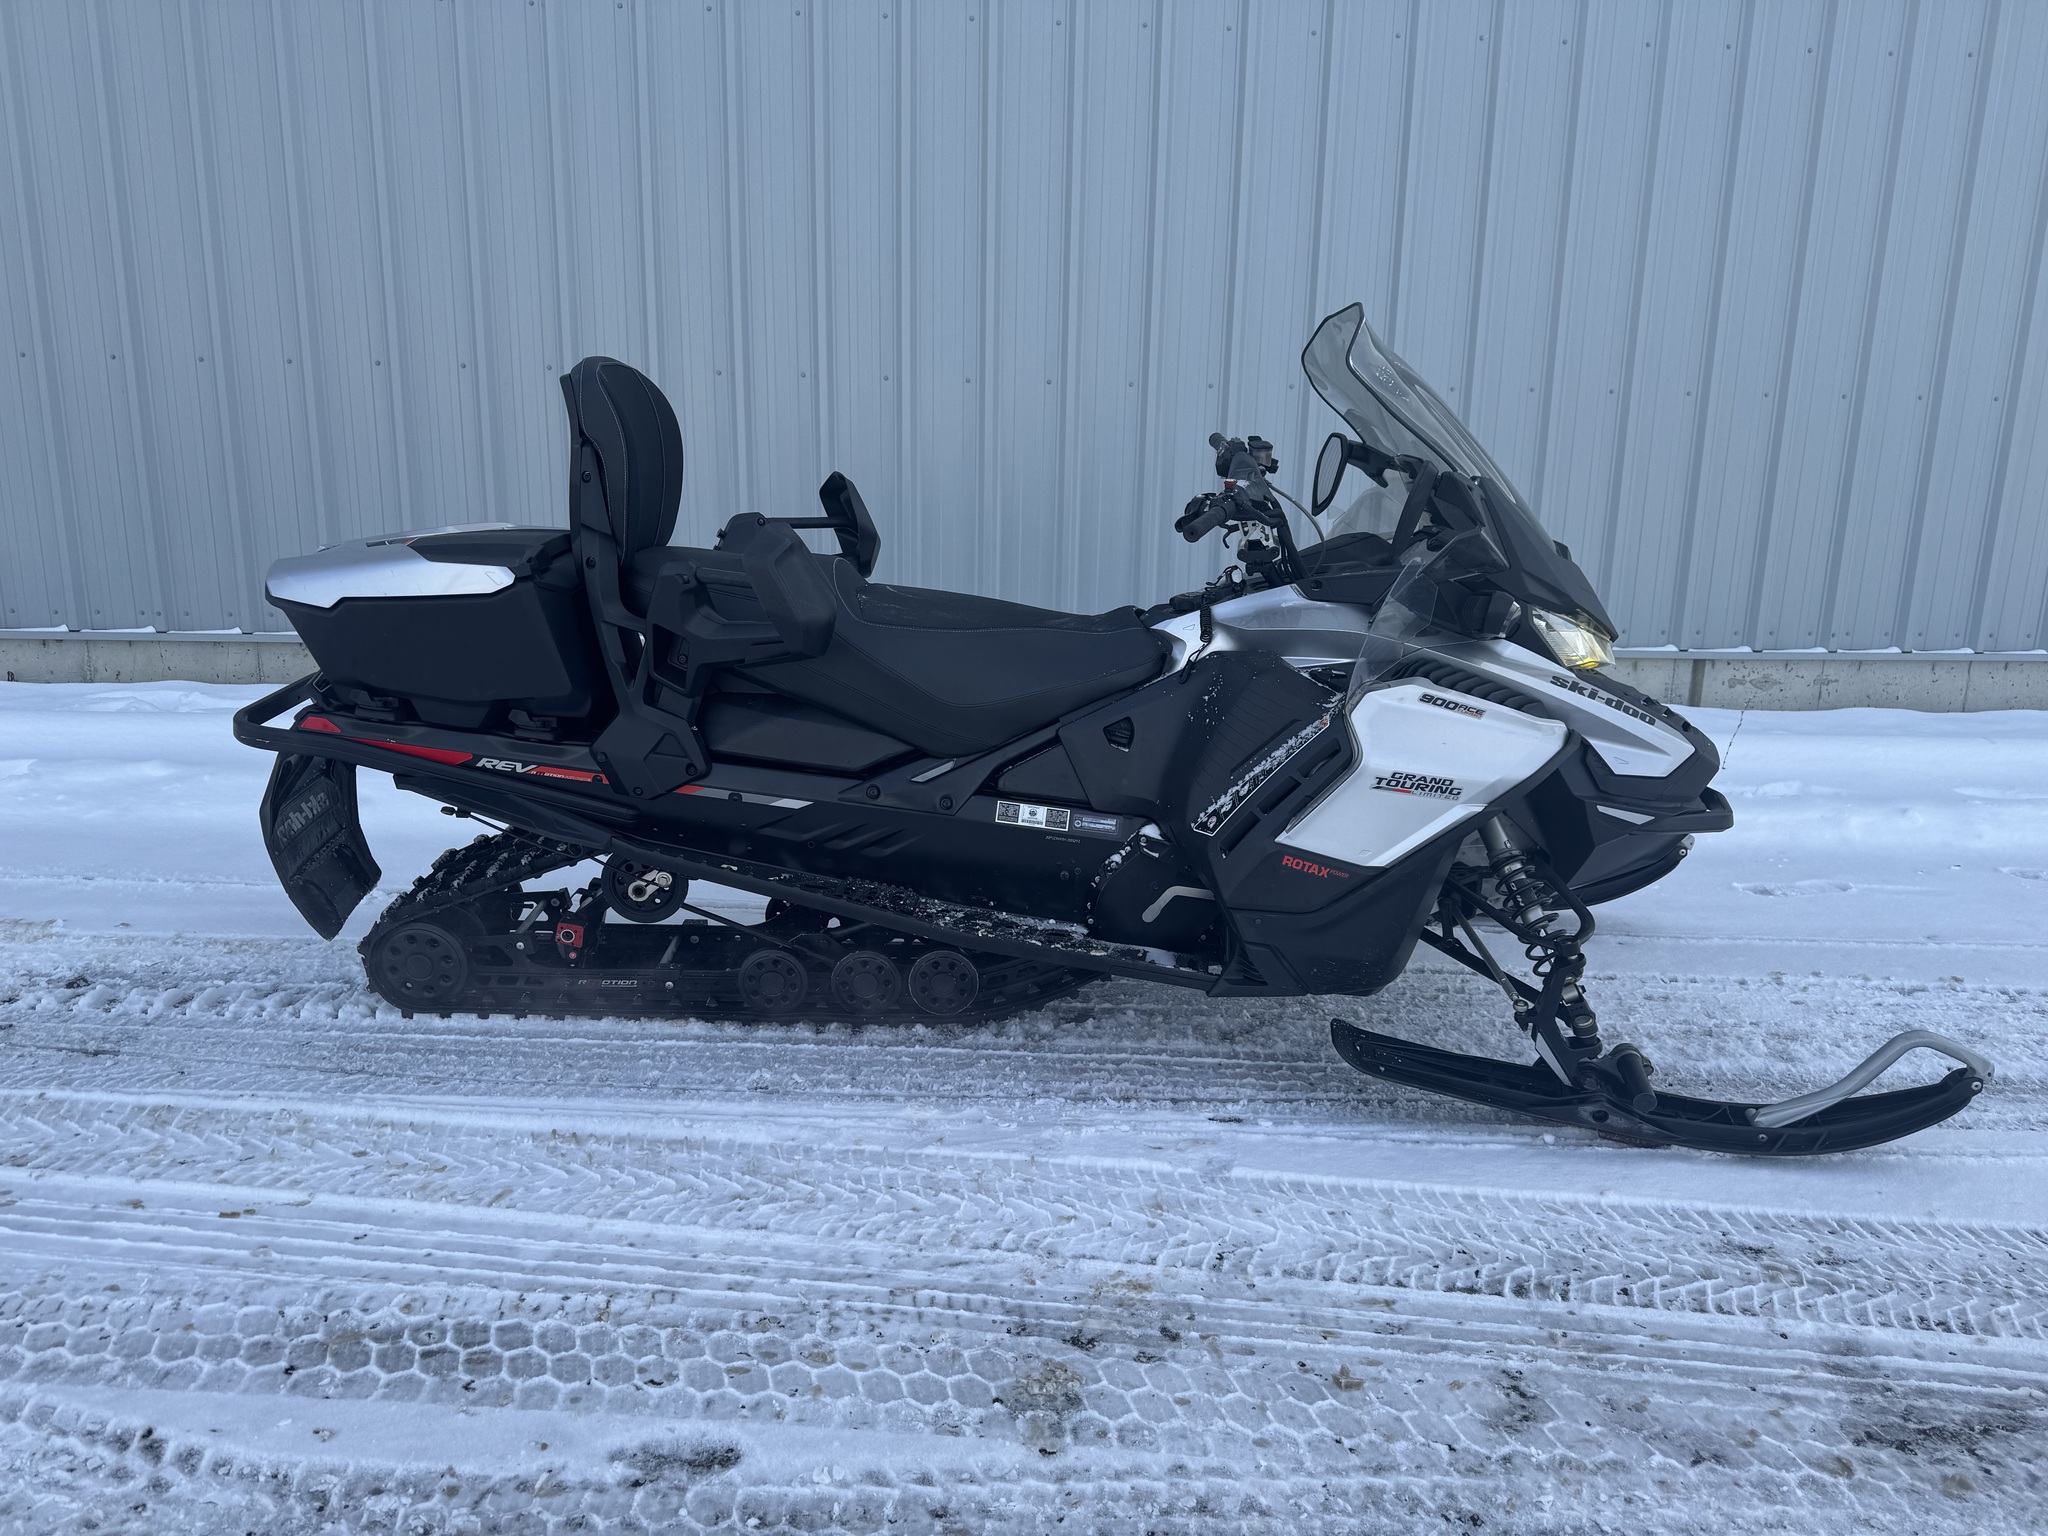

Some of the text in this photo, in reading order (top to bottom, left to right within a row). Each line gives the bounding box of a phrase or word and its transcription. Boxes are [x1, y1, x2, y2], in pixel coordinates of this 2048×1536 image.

[1419, 693, 1485, 716] 900 ACE
[1550, 675, 1657, 726] ski-doo
[475, 757, 539, 774] REV
[1375, 776, 1462, 796] TOURING
[1391, 772, 1454, 787] GRAND
[1412, 790, 1459, 800] LIMITED
[1282, 855, 1330, 878] ROTAX
